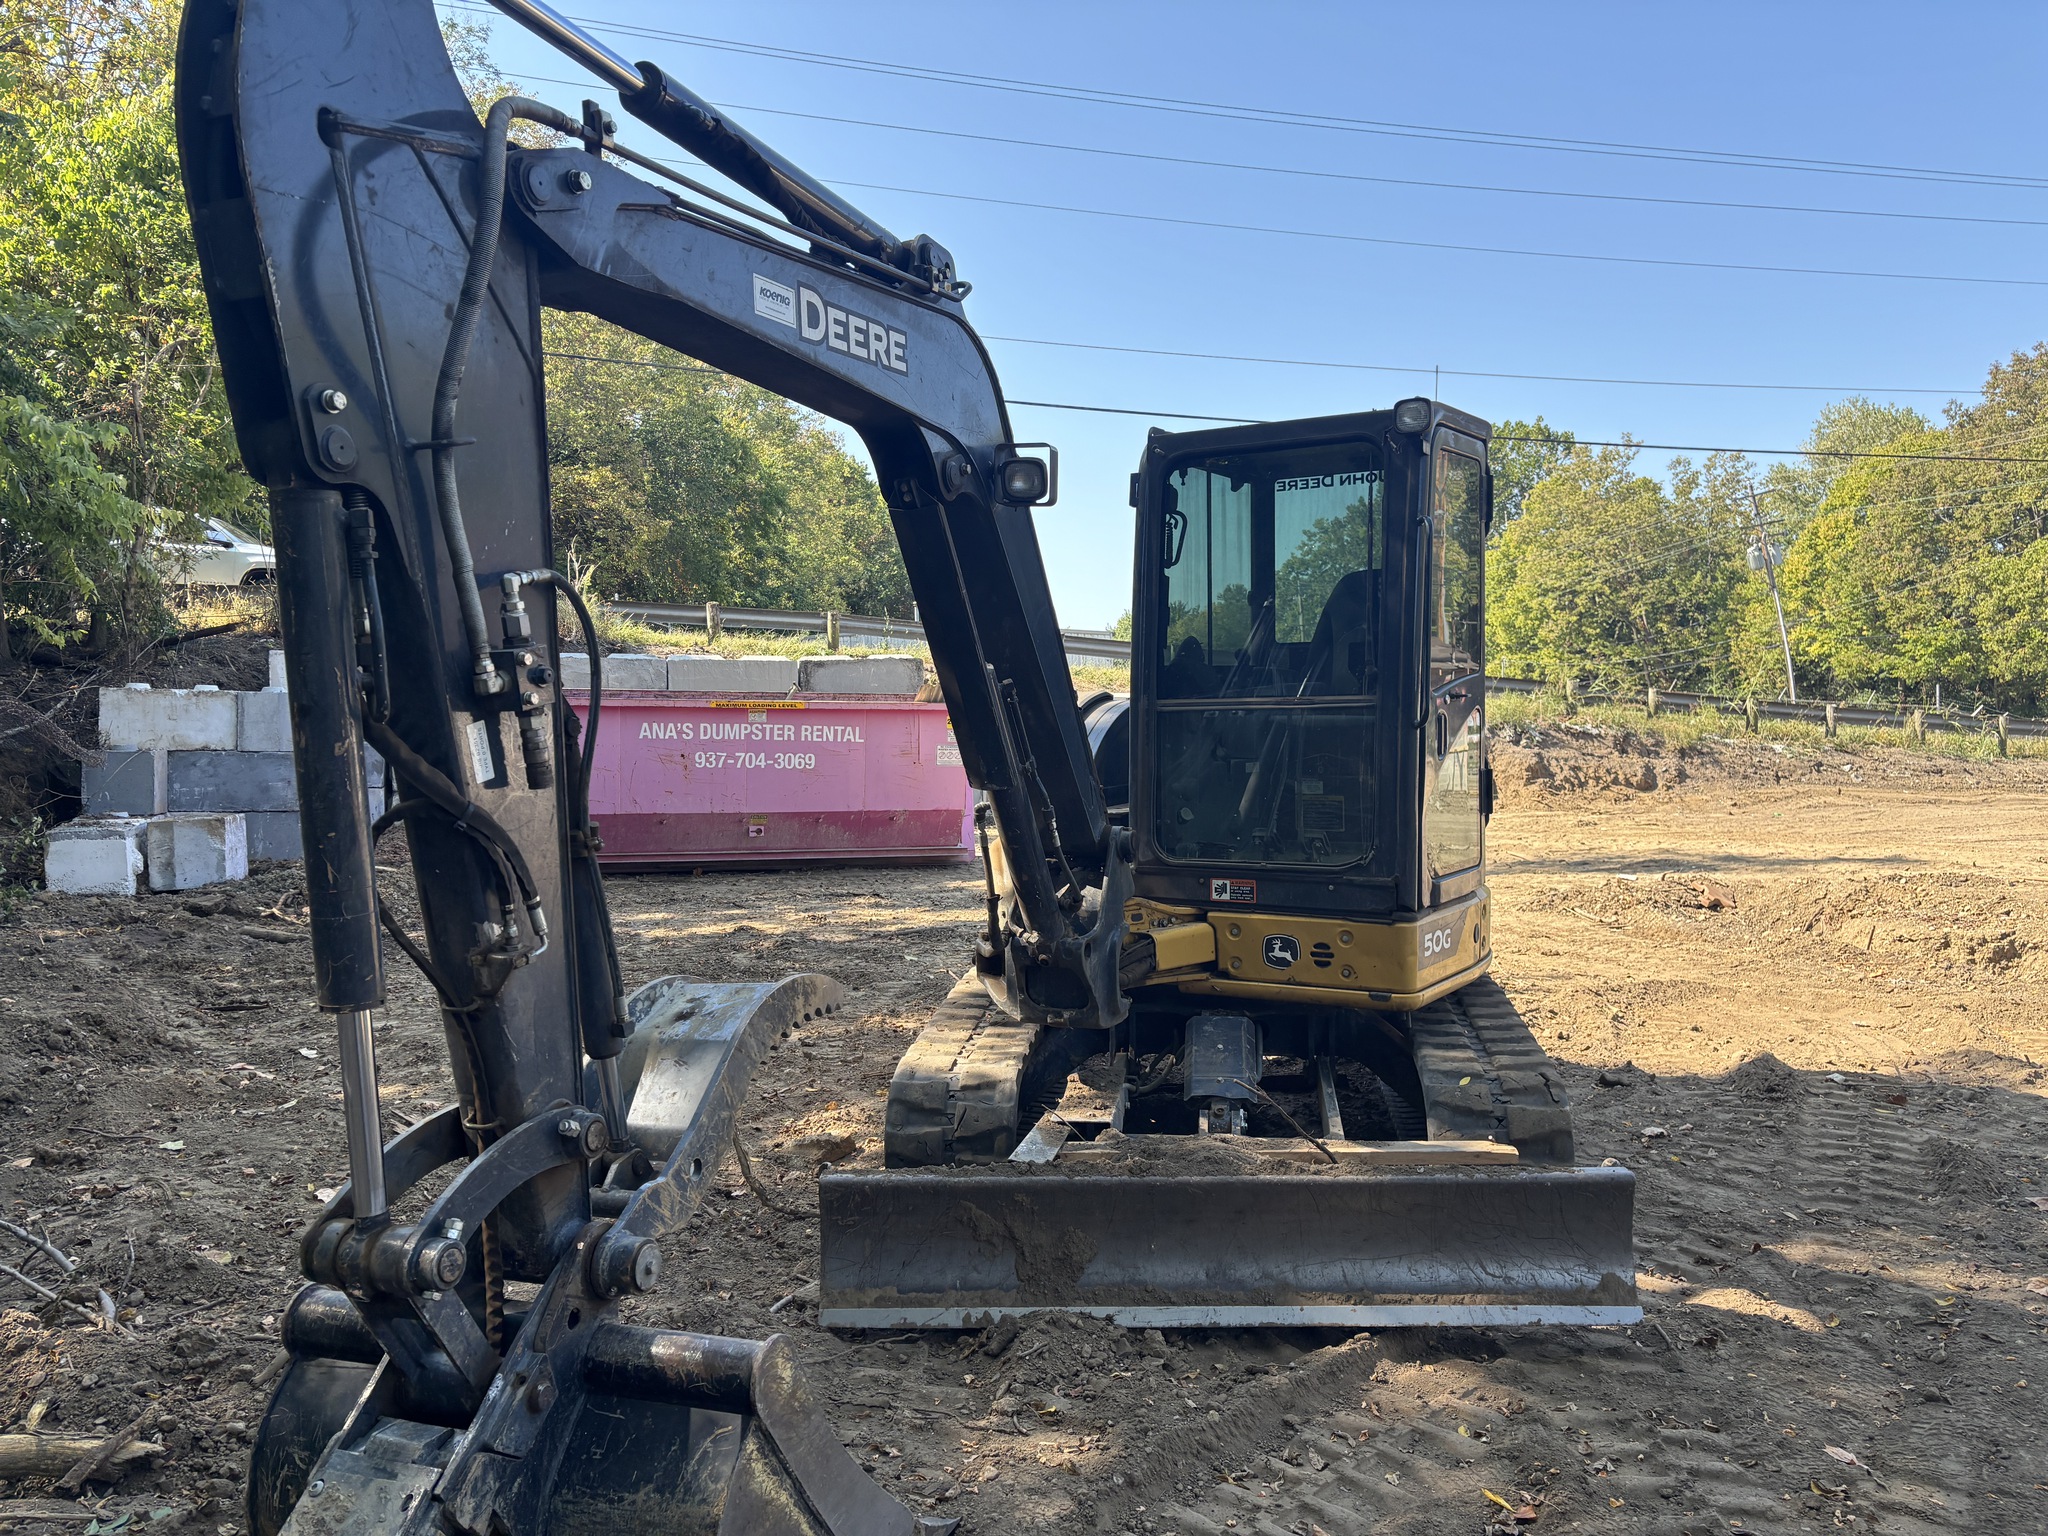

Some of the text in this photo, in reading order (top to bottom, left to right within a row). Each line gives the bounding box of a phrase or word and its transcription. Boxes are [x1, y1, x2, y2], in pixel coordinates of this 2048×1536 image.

[800, 286, 907, 372] DEERE
[640, 722, 864, 742] ANA'S DUMPSTER RENTAL
[694, 752, 816, 769] 937-704-3069
[1424, 928, 1451, 957] 50G
